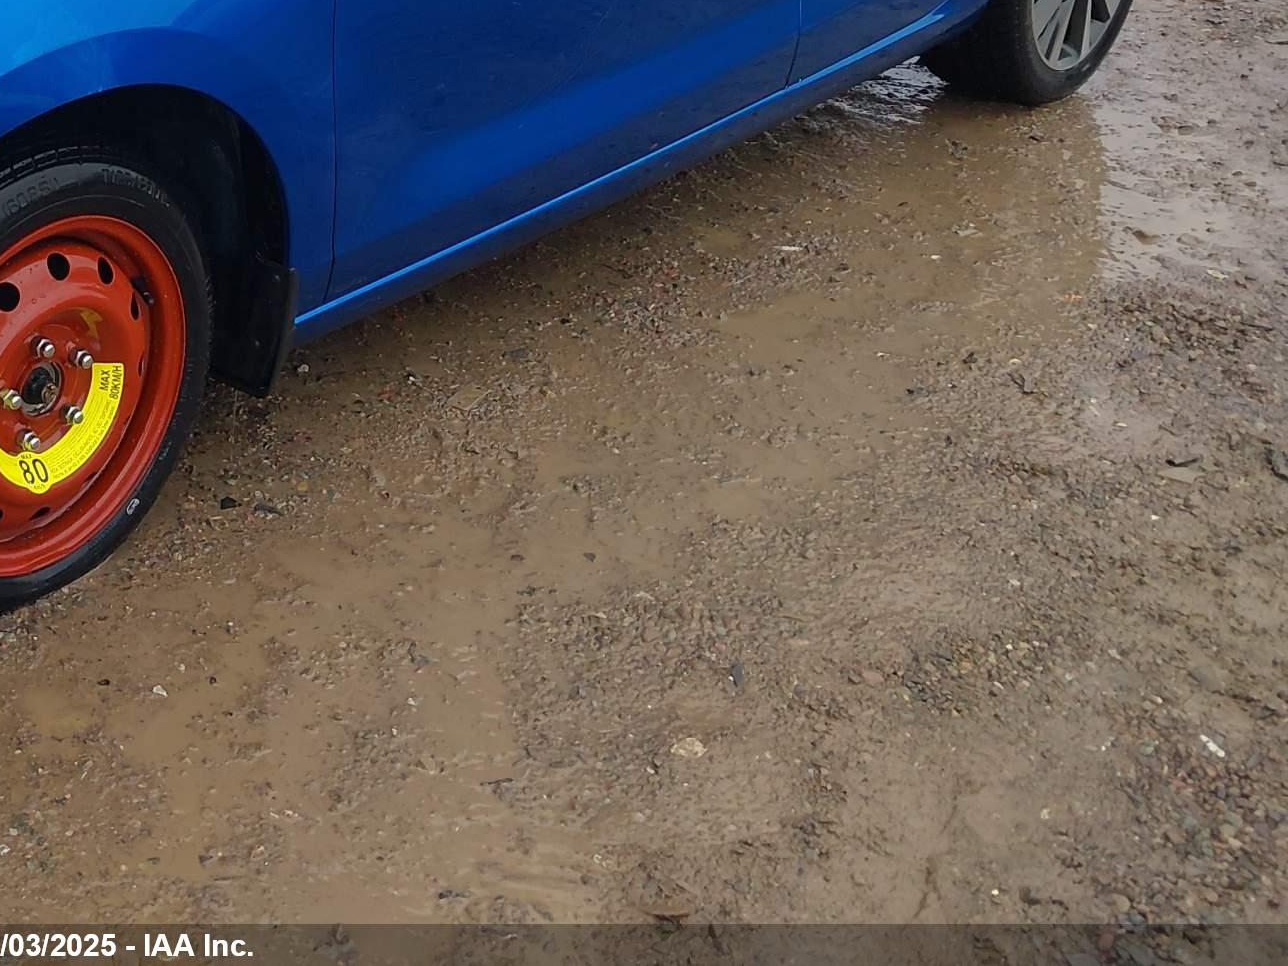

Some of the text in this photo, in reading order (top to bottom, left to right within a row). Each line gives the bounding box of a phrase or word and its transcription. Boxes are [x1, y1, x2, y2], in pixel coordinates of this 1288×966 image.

[99, 369, 111, 391] MAX
[109, 365, 122, 400] 80KM/H
[19, 458, 49, 484] 80
